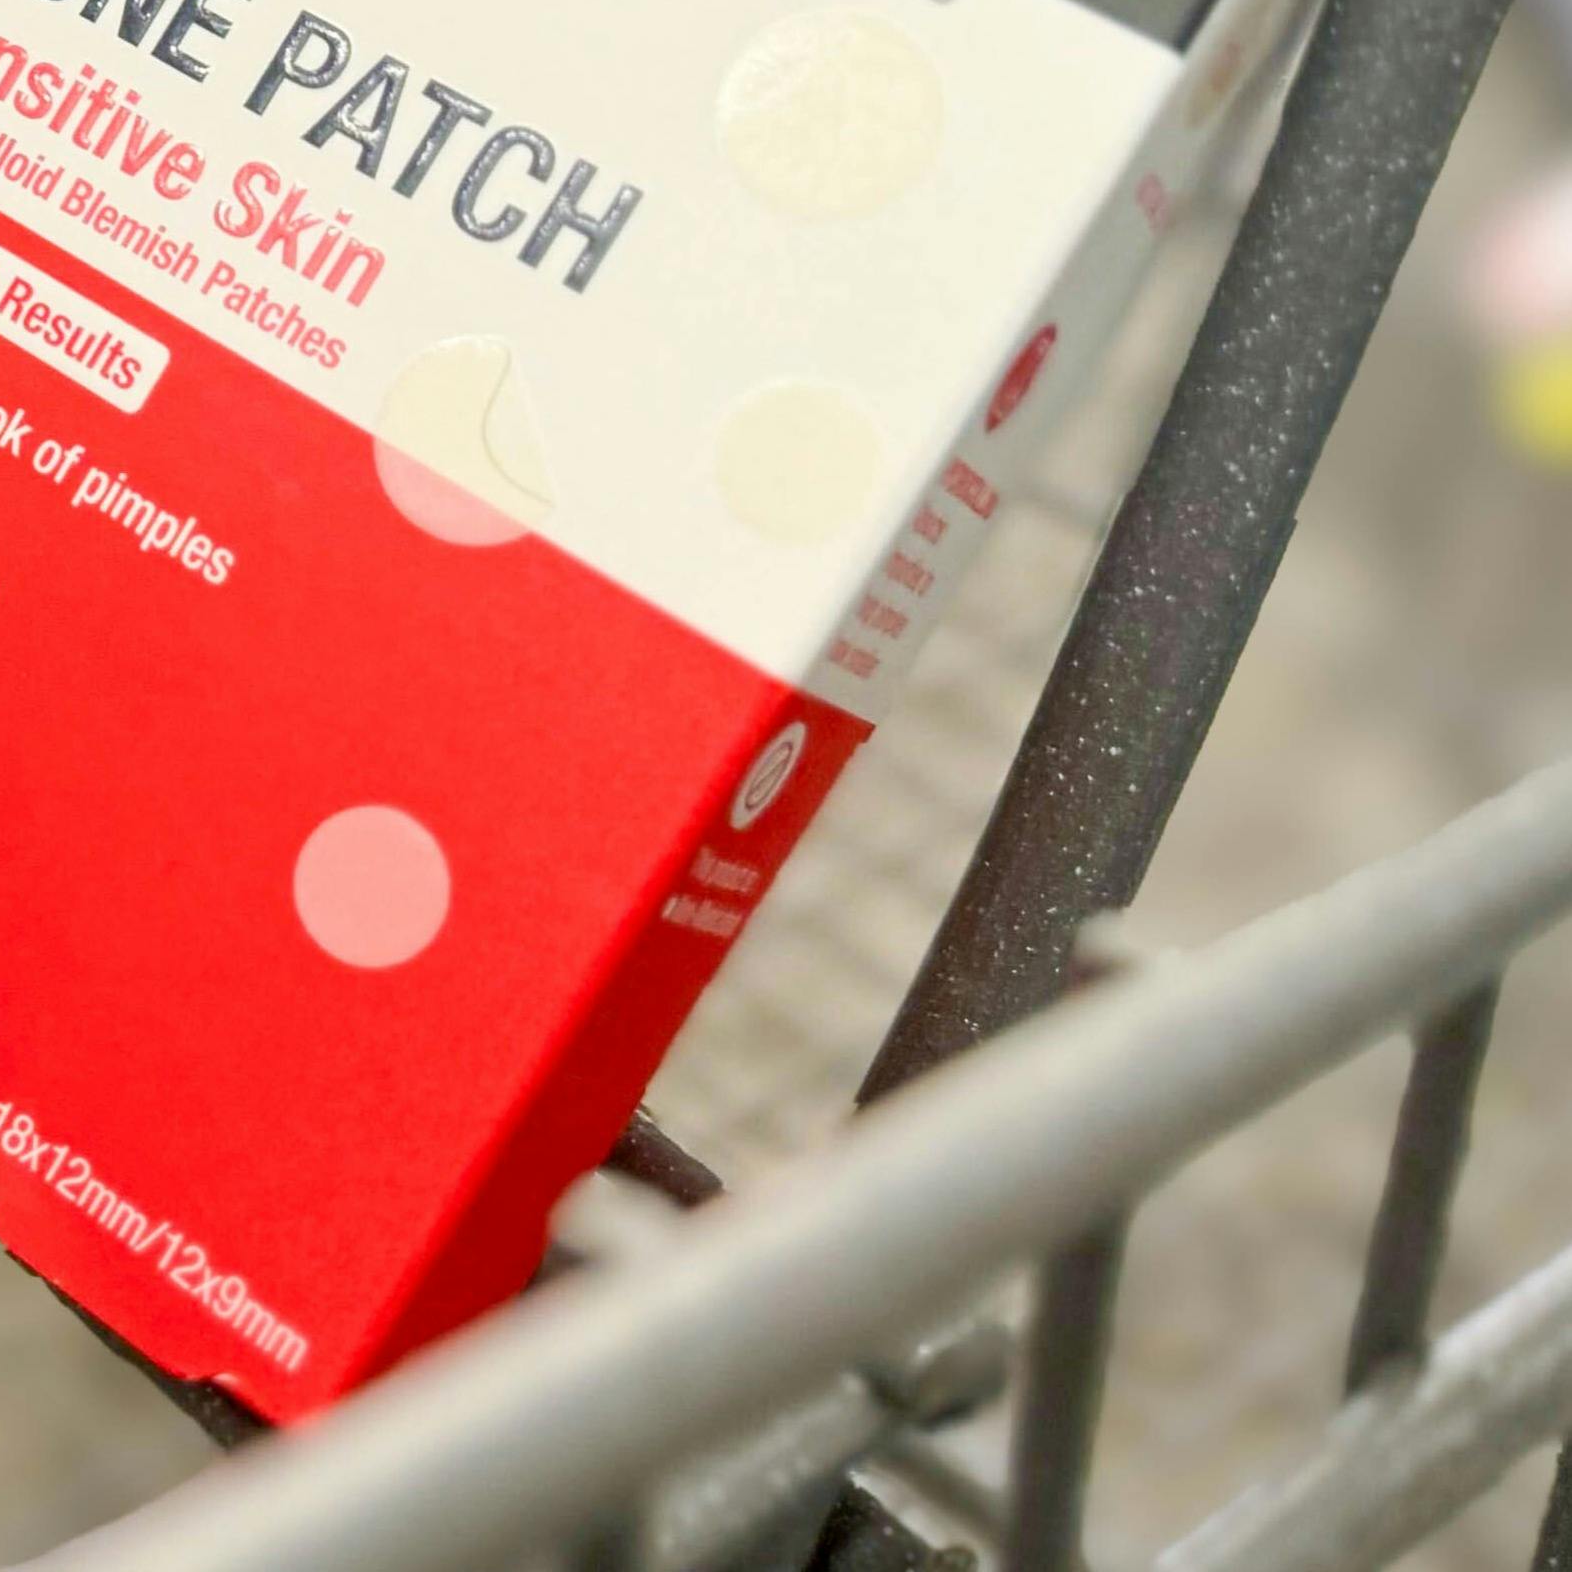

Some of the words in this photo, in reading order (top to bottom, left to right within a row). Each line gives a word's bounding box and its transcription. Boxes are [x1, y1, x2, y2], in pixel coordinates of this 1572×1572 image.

[214, 160, 386, 308] Skin
[243, 10, 644, 295] PATCH
[62, 178, 200, 286] Blemish
[201, 263, 348, 371] Patches
[32, 436, 85, 483] of
[70, 462, 238, 587] pimples
